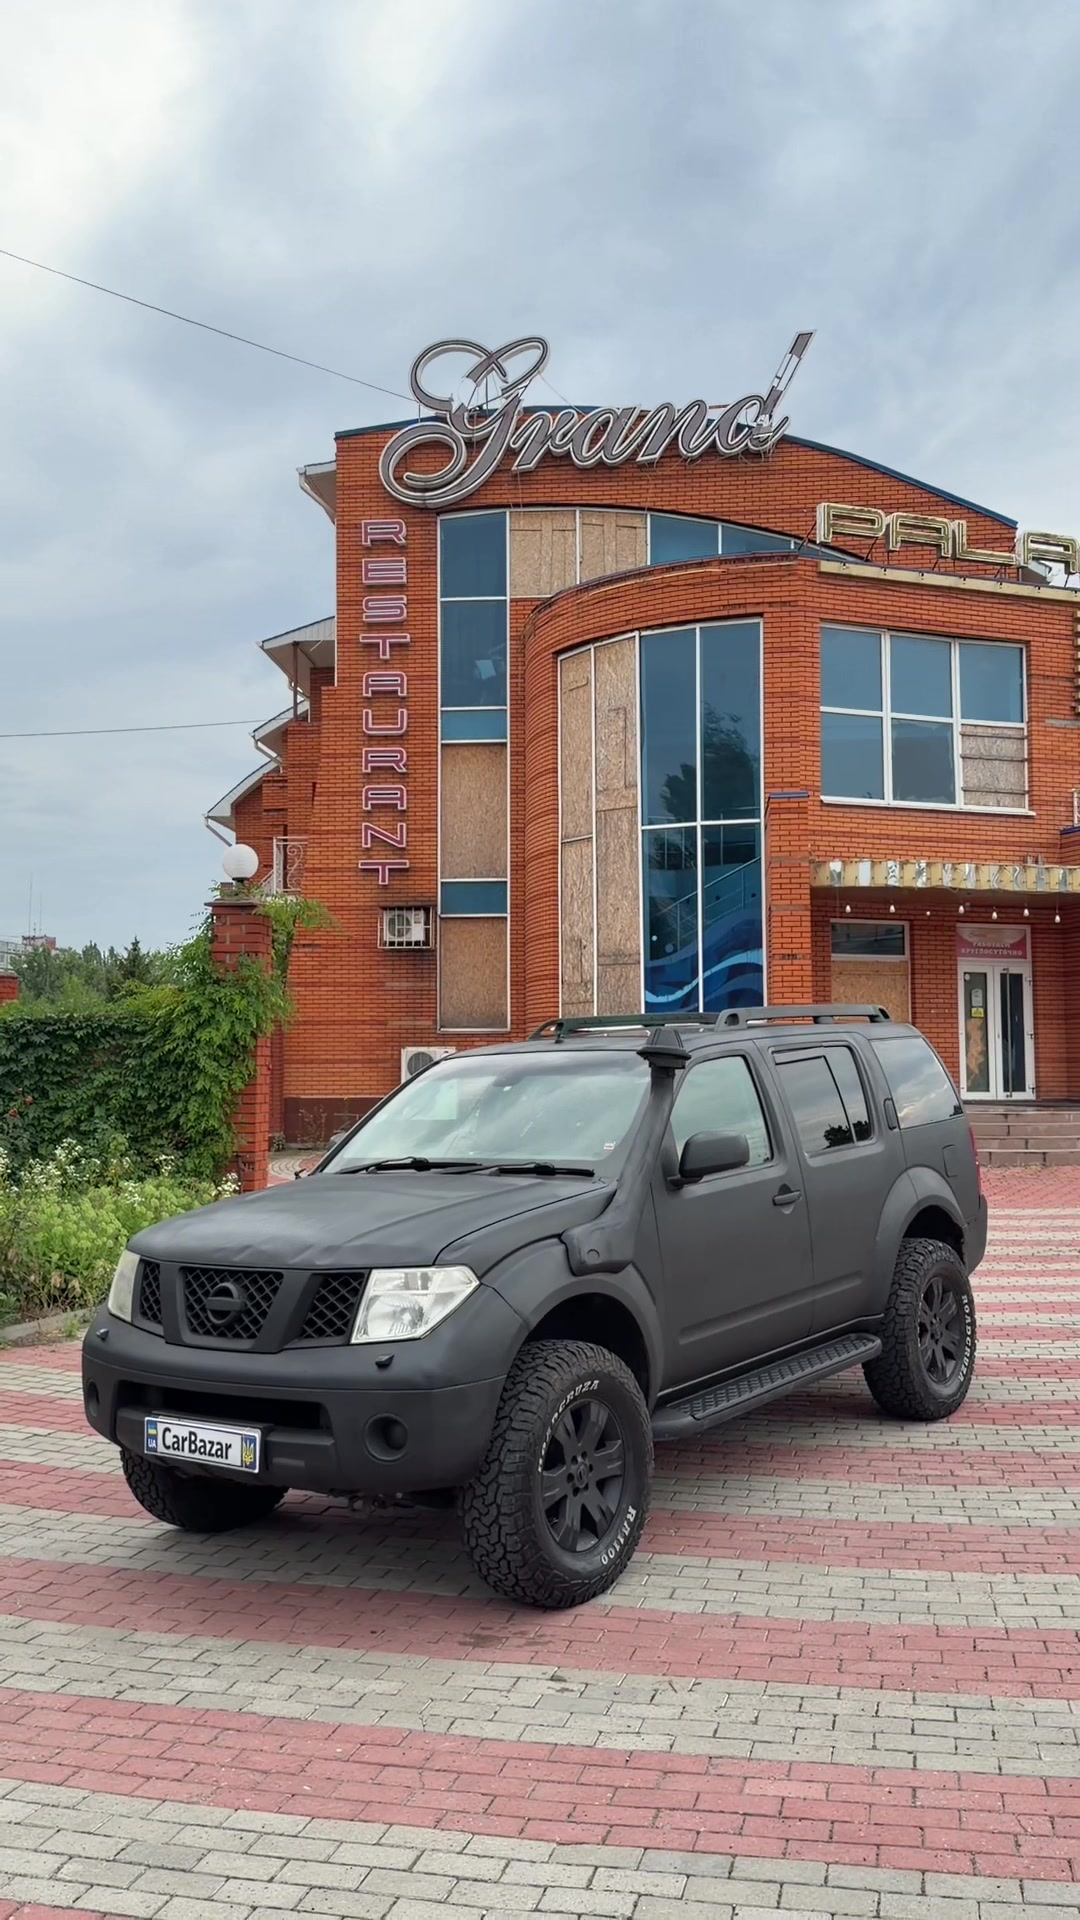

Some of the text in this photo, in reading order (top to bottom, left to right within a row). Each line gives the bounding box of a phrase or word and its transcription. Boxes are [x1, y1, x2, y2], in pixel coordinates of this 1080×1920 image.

[379, 329, 817, 508] Grand
[358, 519, 411, 886] RESTAURANT
[960, 948, 1023, 956] КРУГЛОСУТОЧНО
[147, 1427, 232, 1460] UA CarBazar
